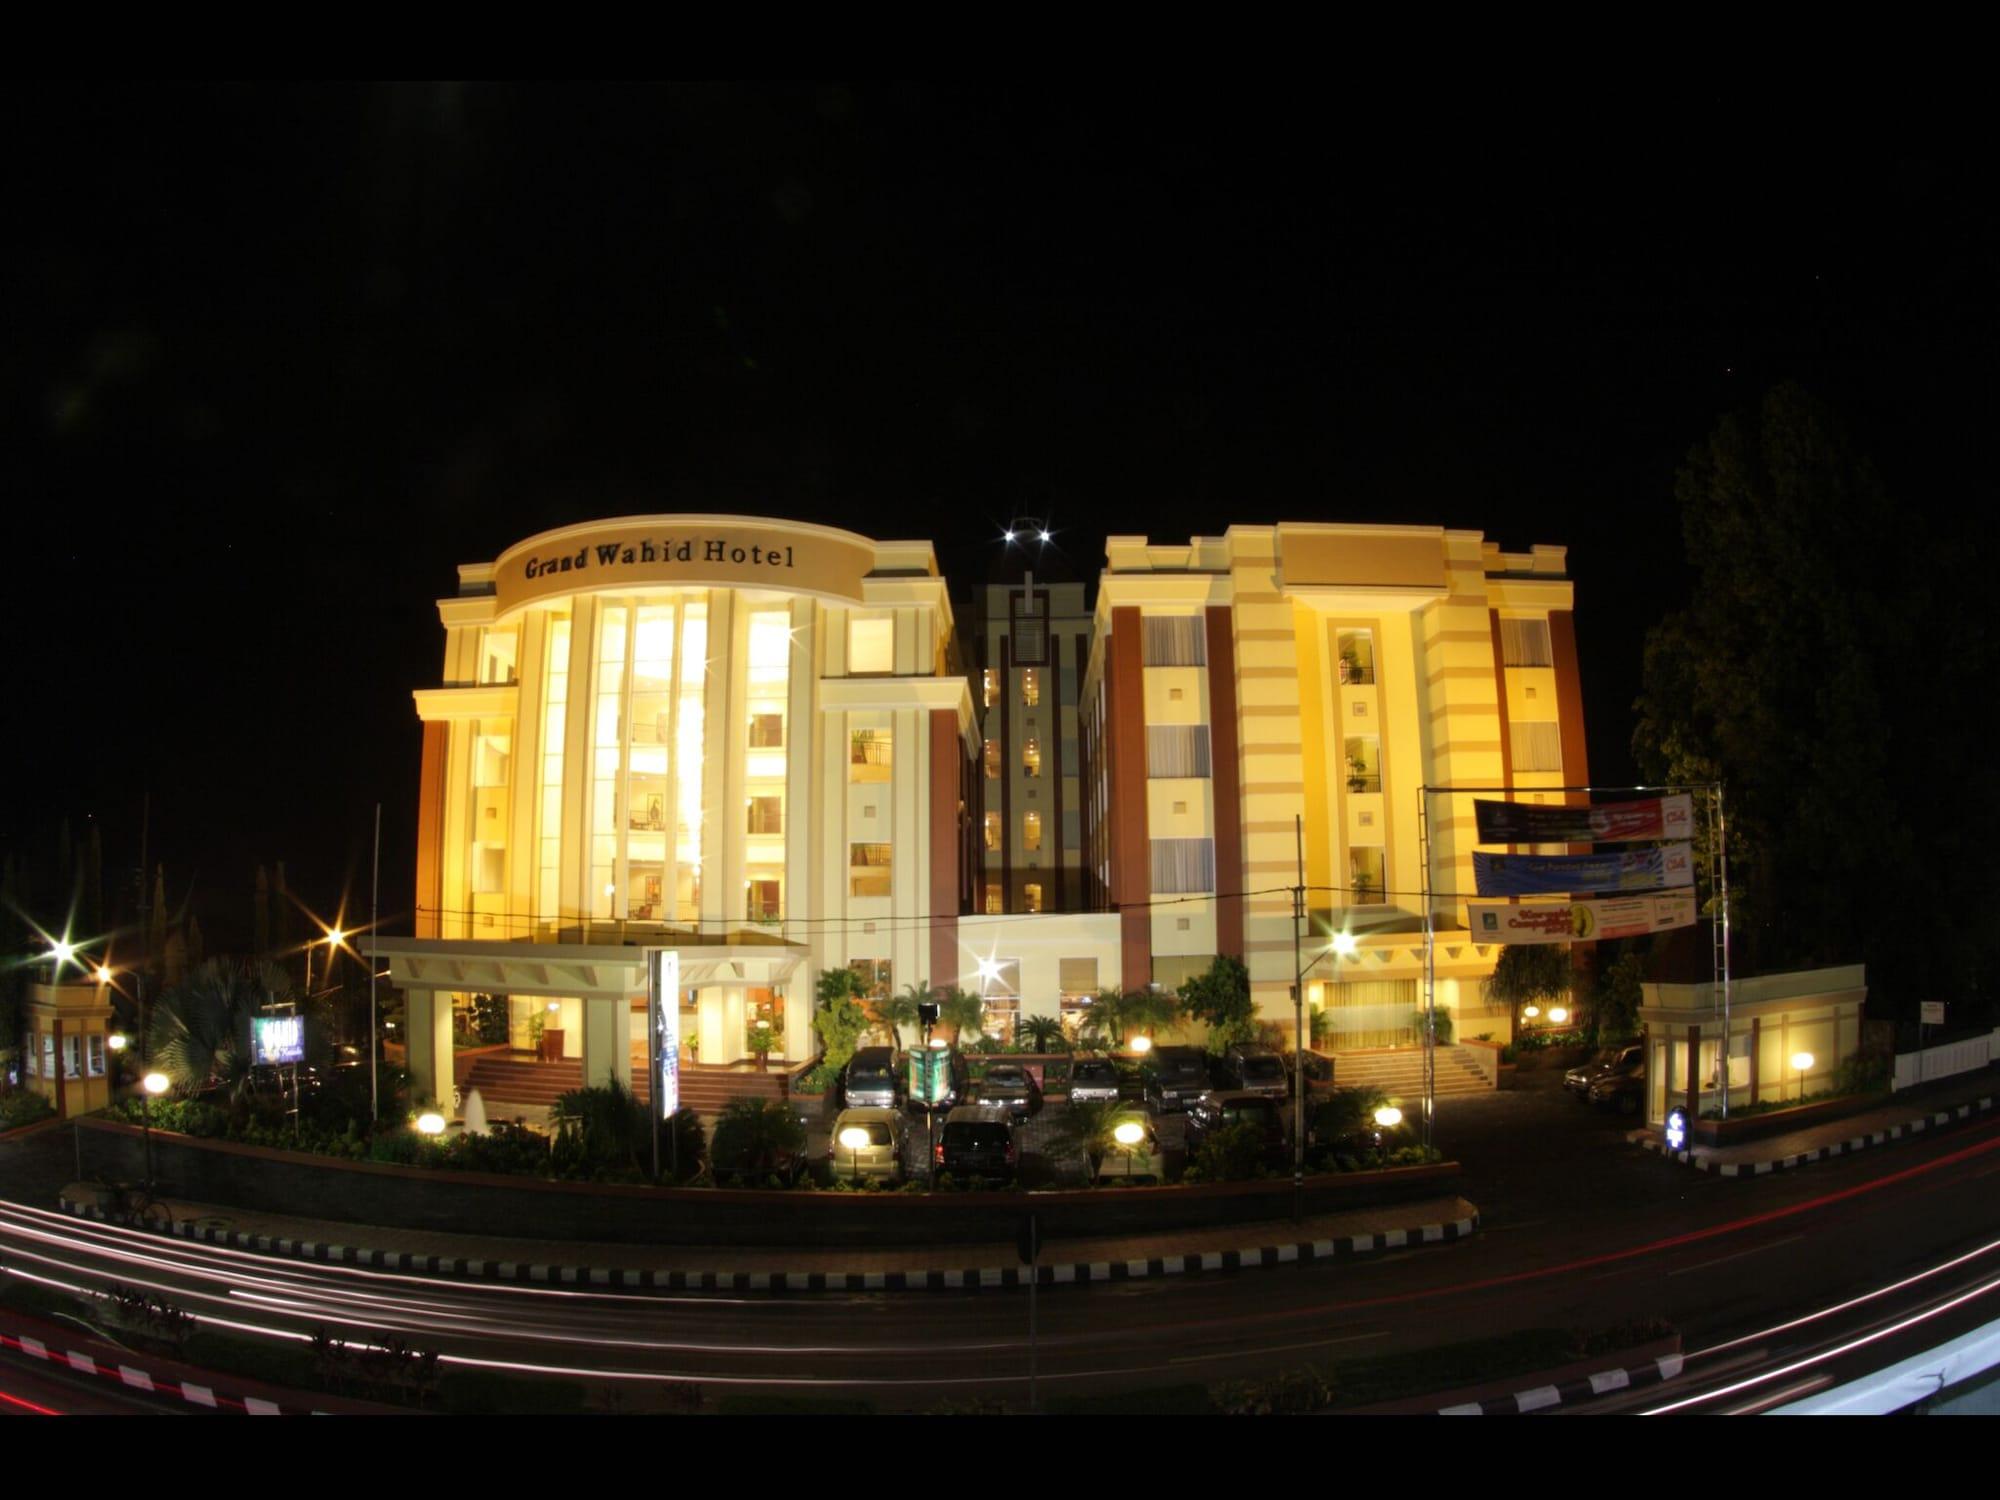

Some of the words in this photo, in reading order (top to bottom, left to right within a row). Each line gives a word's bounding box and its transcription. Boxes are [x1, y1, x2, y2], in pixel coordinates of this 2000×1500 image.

[525, 546, 588, 579] Grand
[595, 540, 691, 566] Wahid
[704, 540, 794, 568] Hotel
